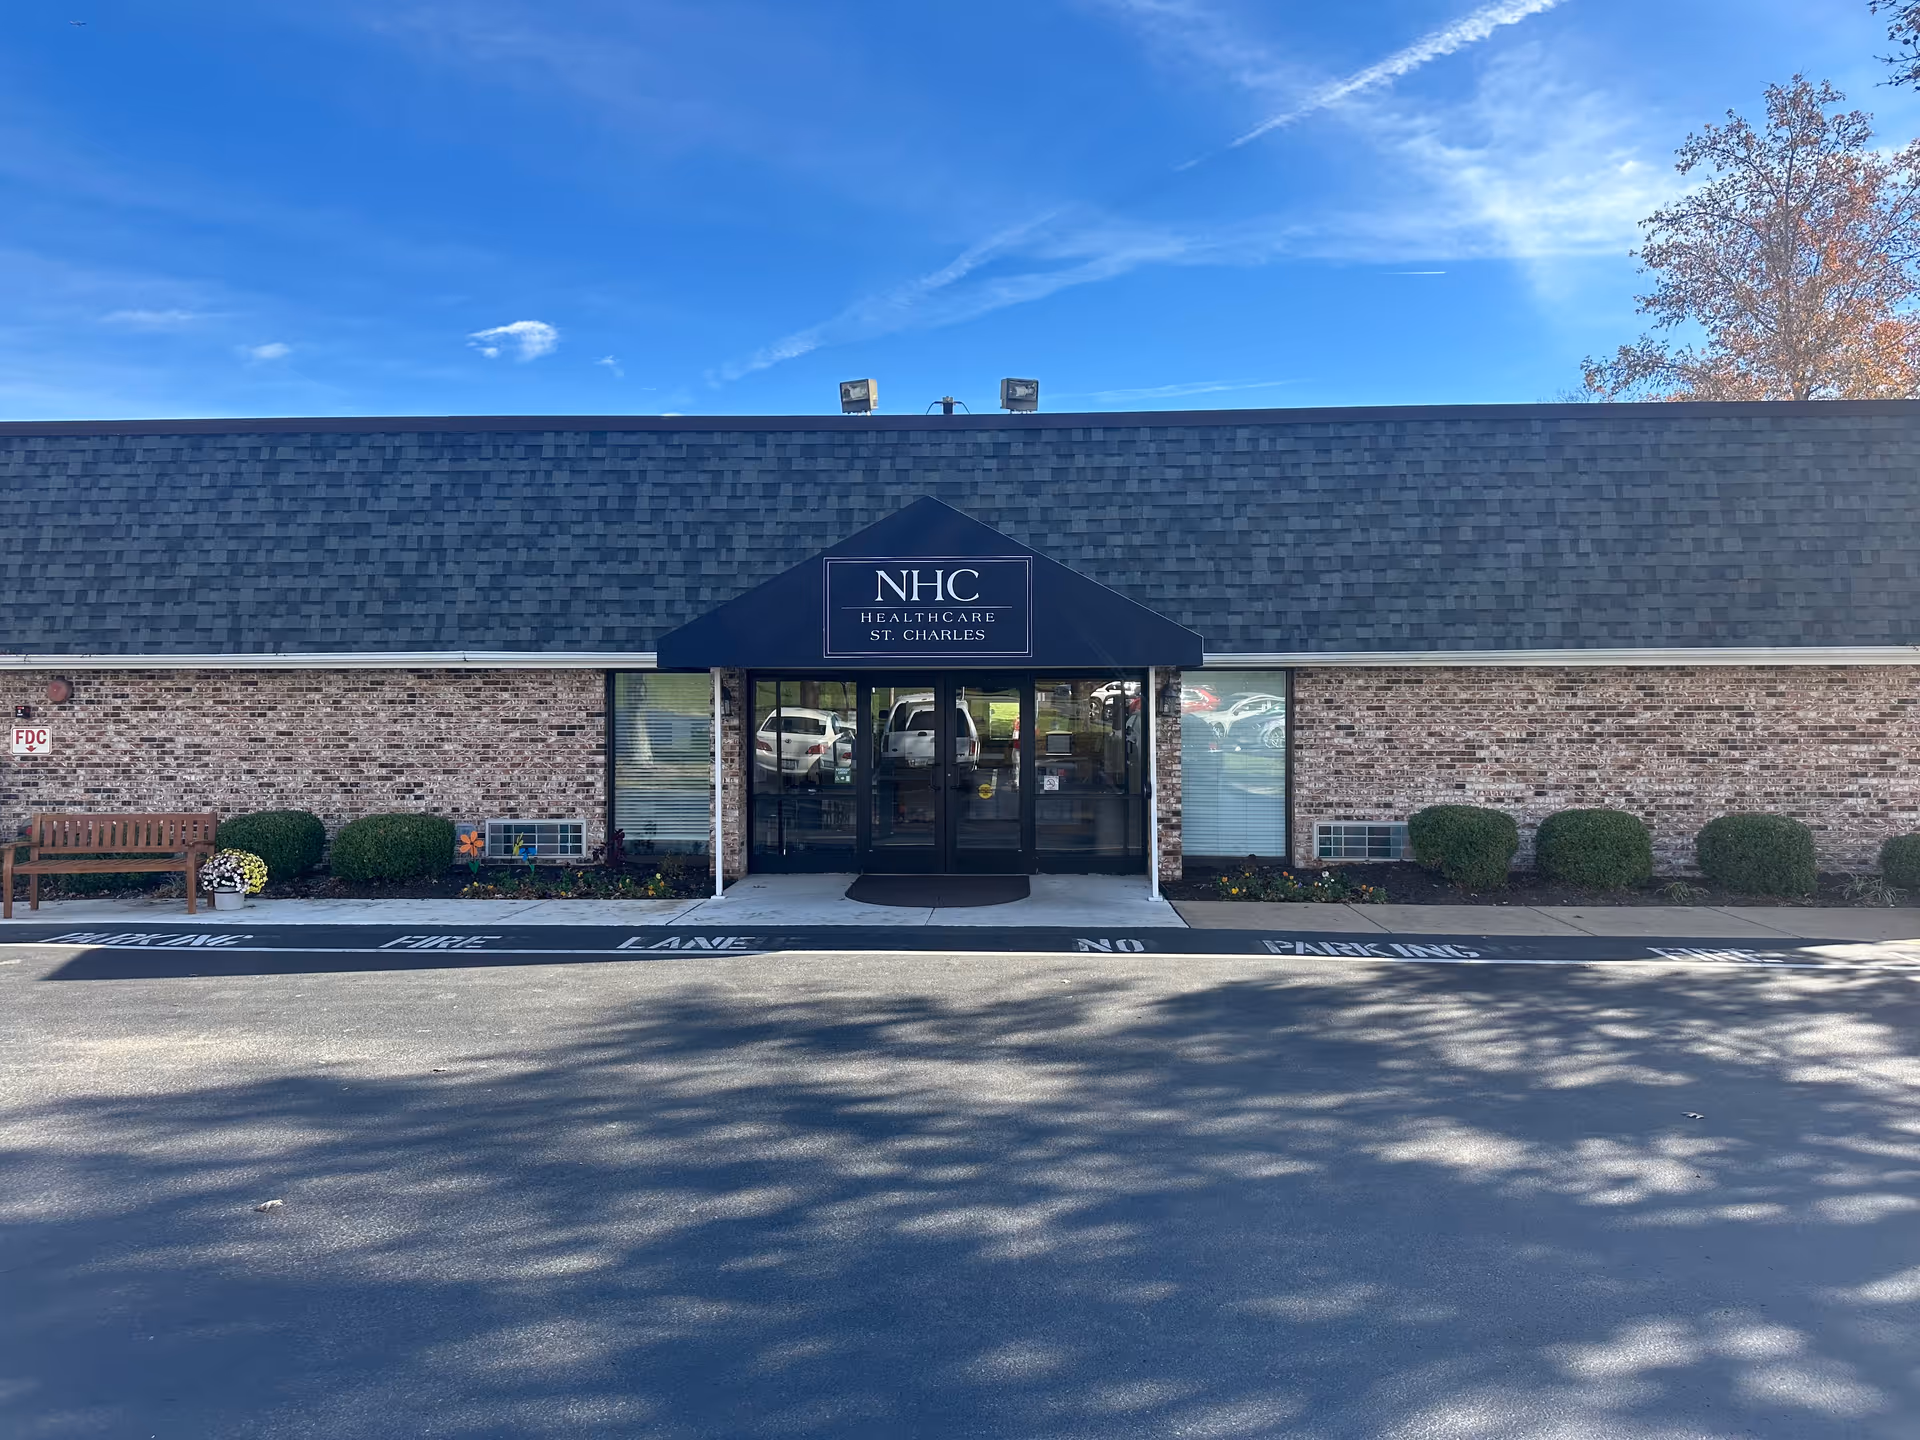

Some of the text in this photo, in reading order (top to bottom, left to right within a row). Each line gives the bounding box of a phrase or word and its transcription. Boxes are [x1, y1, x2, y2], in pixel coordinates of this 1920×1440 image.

[875, 568, 980, 602] NHC
[869, 629, 986, 641] ST. CHARLES
[15, 729, 47, 745] FDC
[38, 932, 254, 947] PARKING
[378, 935, 503, 949] FIRE
[616, 936, 756, 949] LANE
[1075, 938, 1146, 953] NO
[1262, 939, 1480, 959] PARKING
